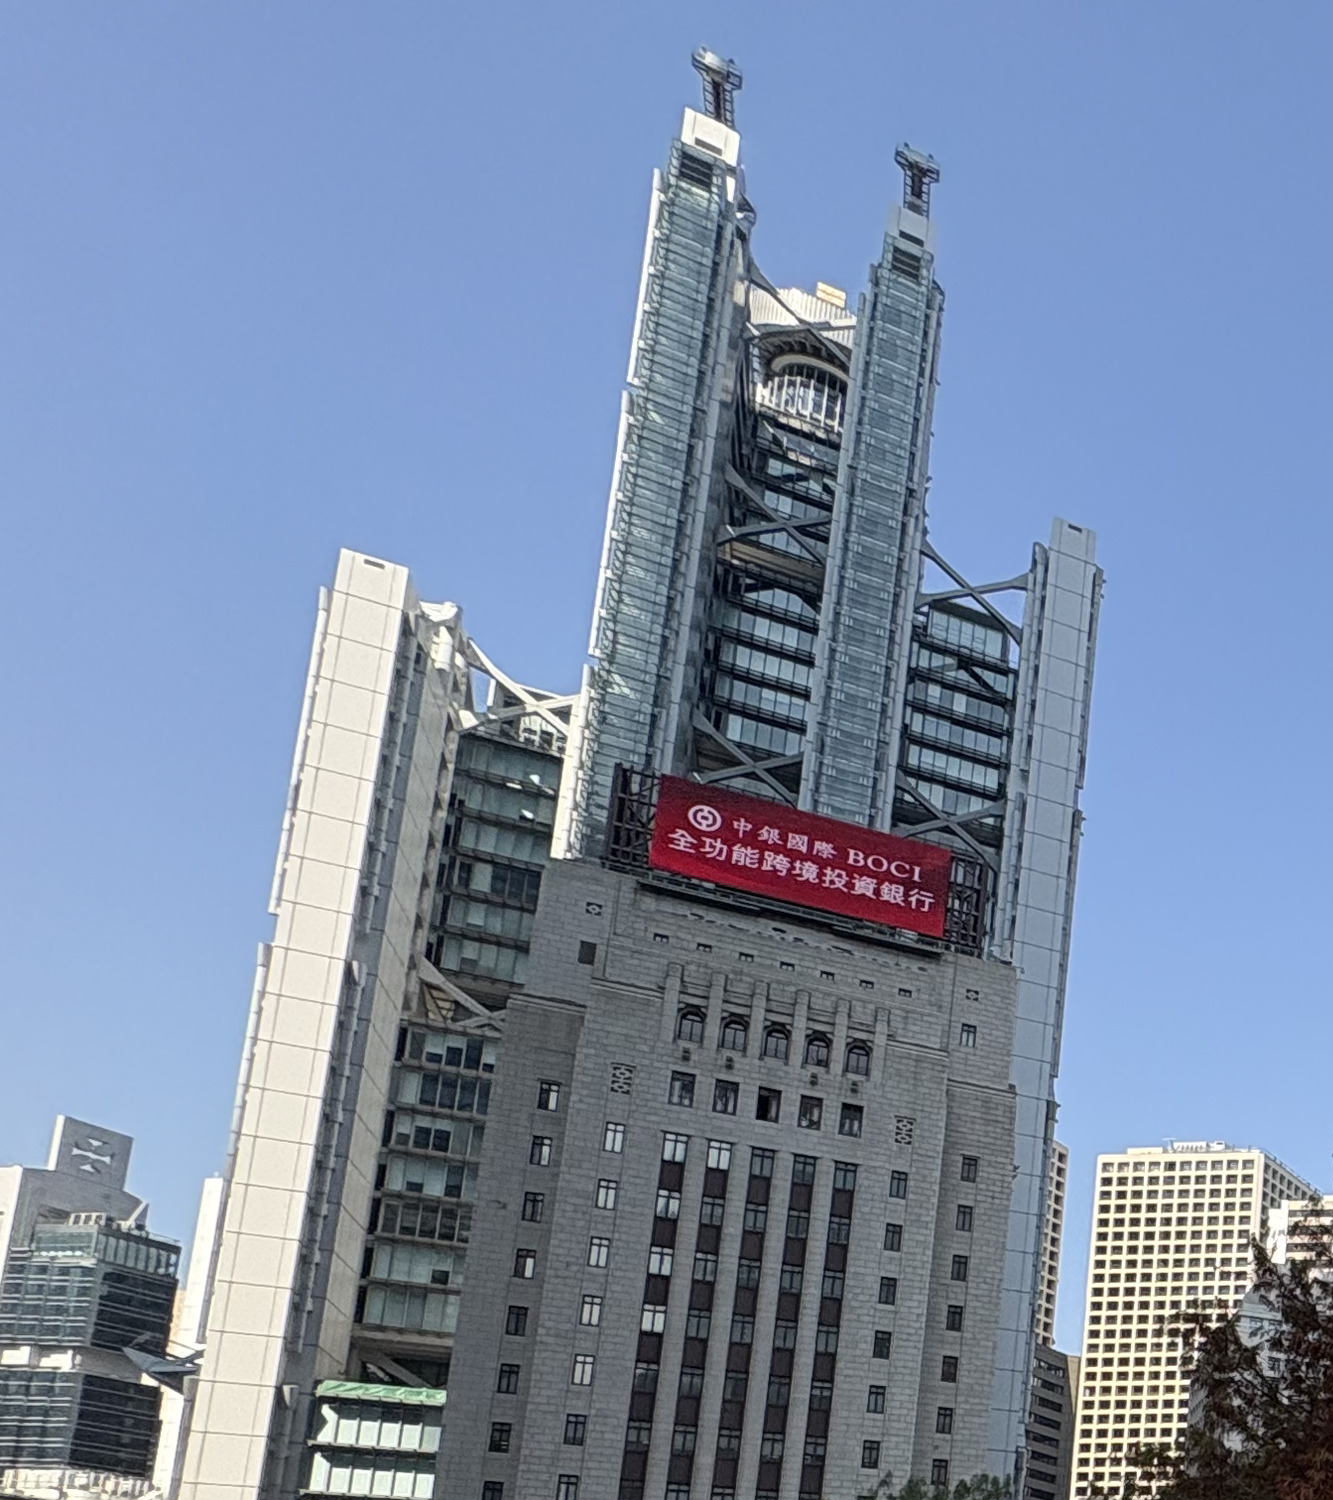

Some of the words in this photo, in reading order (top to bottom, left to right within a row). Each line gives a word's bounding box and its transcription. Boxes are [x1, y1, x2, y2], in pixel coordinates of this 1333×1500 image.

[667, 828, 936, 913] 全功能跨境投資銀行
[732, 817, 838, 860] 中銀國際
[847, 848, 922, 882] BOCI
